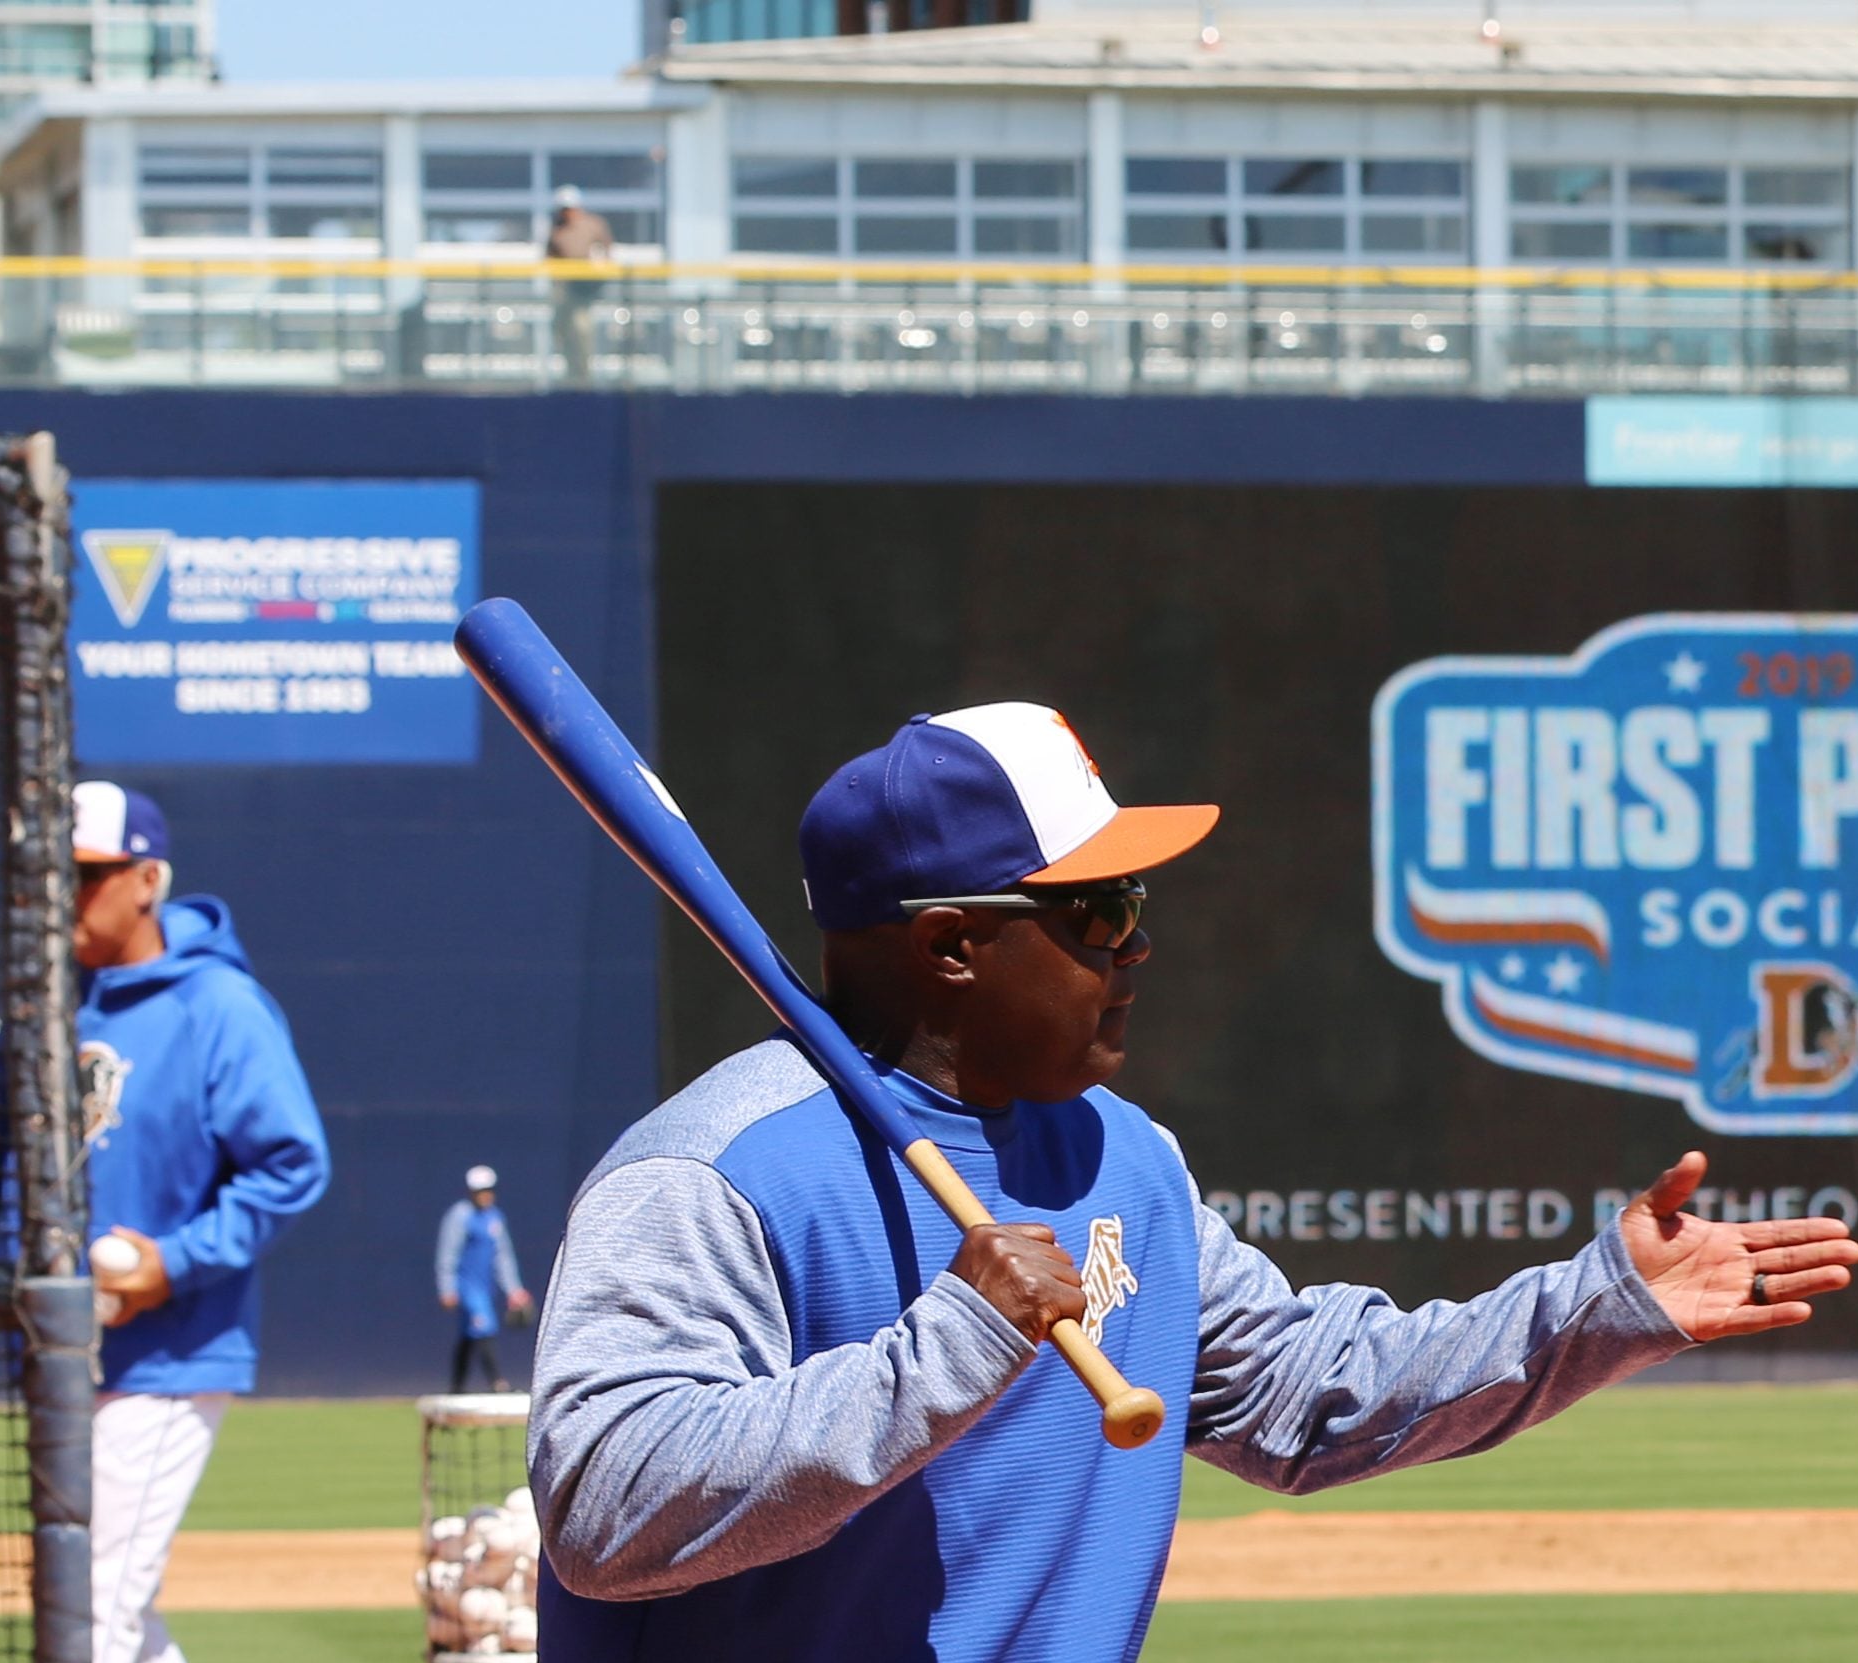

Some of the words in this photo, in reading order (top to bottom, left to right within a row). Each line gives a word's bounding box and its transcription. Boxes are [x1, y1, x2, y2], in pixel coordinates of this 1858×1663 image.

[167, 536, 462, 575] PROGRESSIVE
[77, 641, 173, 678] YOUR
[176, 641, 370, 678] HOMETOWN
[1737, 652, 1855, 696] 2019
[175, 678, 280, 714] SINCE
[1424, 707, 1771, 870] FIRST
[1205, 1189, 1573, 1241] PRESENTED
